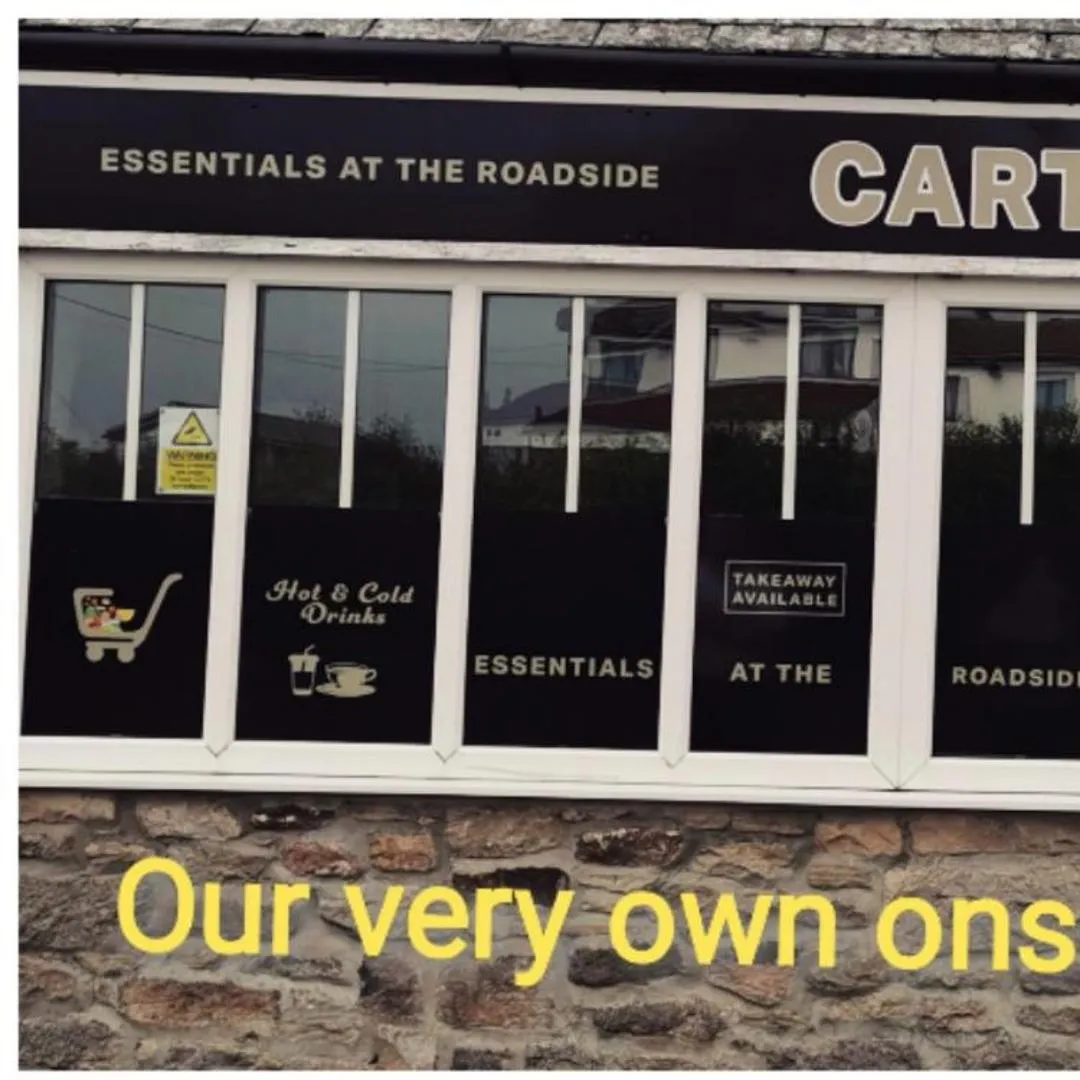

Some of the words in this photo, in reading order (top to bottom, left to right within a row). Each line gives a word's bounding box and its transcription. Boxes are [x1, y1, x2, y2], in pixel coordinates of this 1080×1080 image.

[101, 147, 327, 179] ESSENTIALS
[339, 156, 383, 181] AT
[395, 157, 464, 184] THE
[477, 160, 660, 188] ROADSIDE
[265, 579, 321, 601] Hot
[331, 583, 349, 602] &
[358, 581, 415, 604] Cold
[733, 572, 836, 588] TAKEAWAY
[732, 590, 837, 607] AVAILABLE
[300, 601, 387, 624] Drinks
[474, 655, 654, 680] ESSENTIALS
[730, 661, 766, 682] AT
[775, 664, 832, 684] THE
